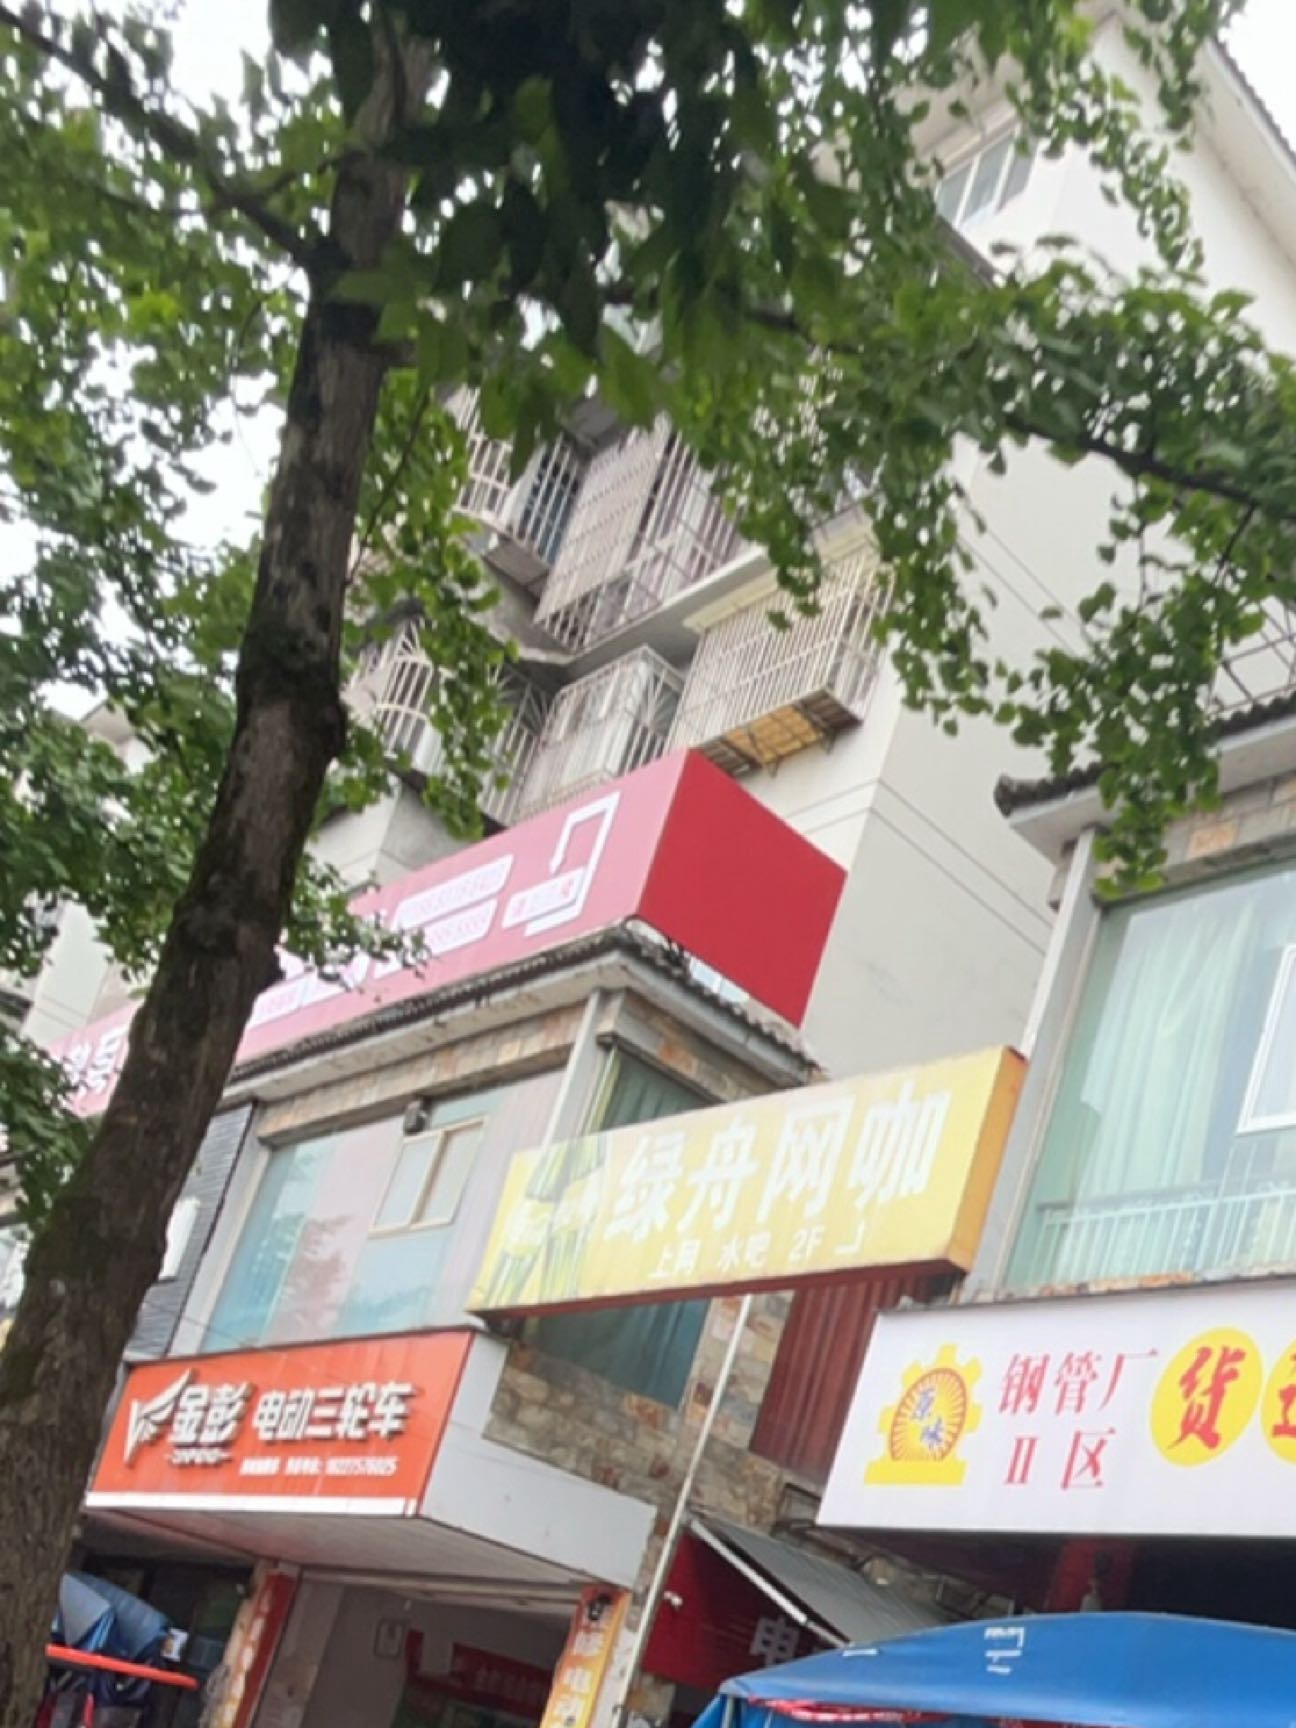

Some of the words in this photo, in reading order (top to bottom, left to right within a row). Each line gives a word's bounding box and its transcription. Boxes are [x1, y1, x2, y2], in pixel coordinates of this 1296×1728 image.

[252, 1381, 417, 1441] 电动三轮车
[998, 1348, 1159, 1419] 钢管厂
